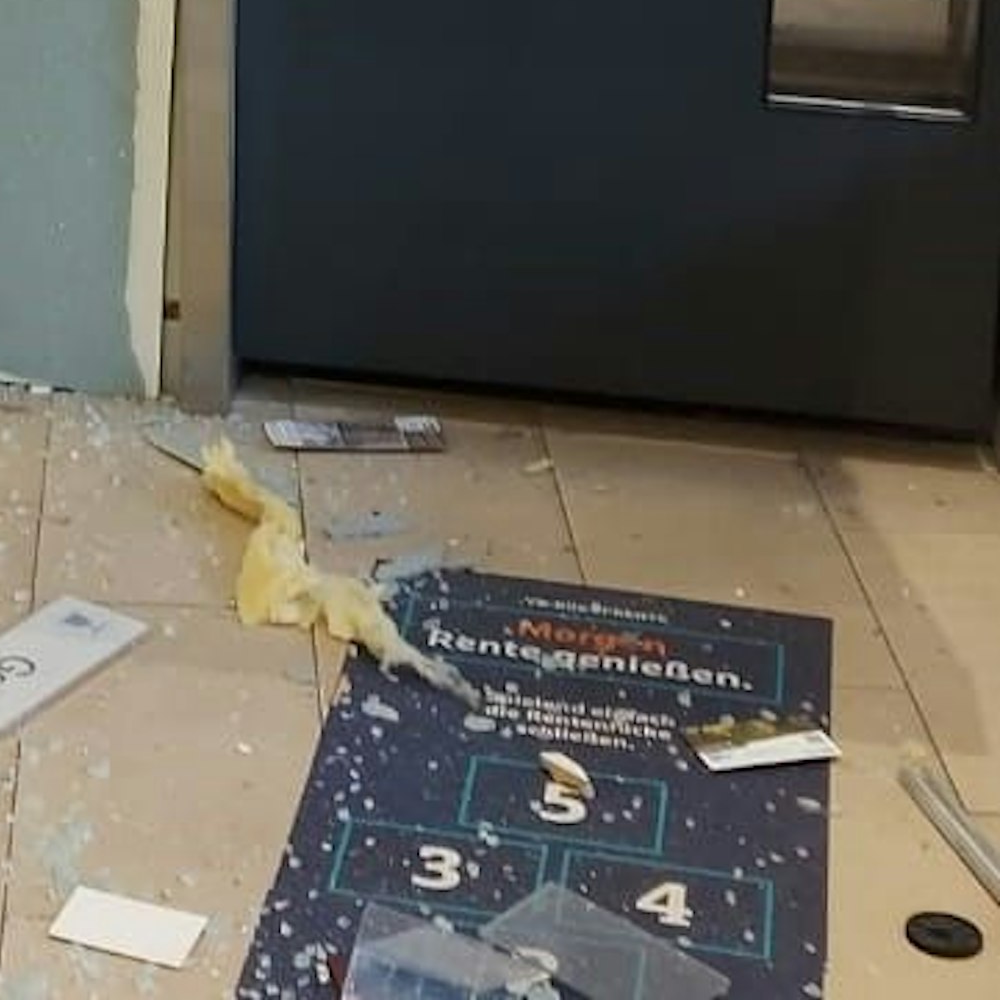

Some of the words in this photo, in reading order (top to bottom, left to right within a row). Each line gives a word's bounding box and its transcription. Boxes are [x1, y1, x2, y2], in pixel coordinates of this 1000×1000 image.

[426, 628, 544, 664] Rente
[552, 648, 754, 692] genießen.
[538, 780, 588, 825] 5
[411, 845, 462, 892] 3
[635, 880, 694, 928] 4
